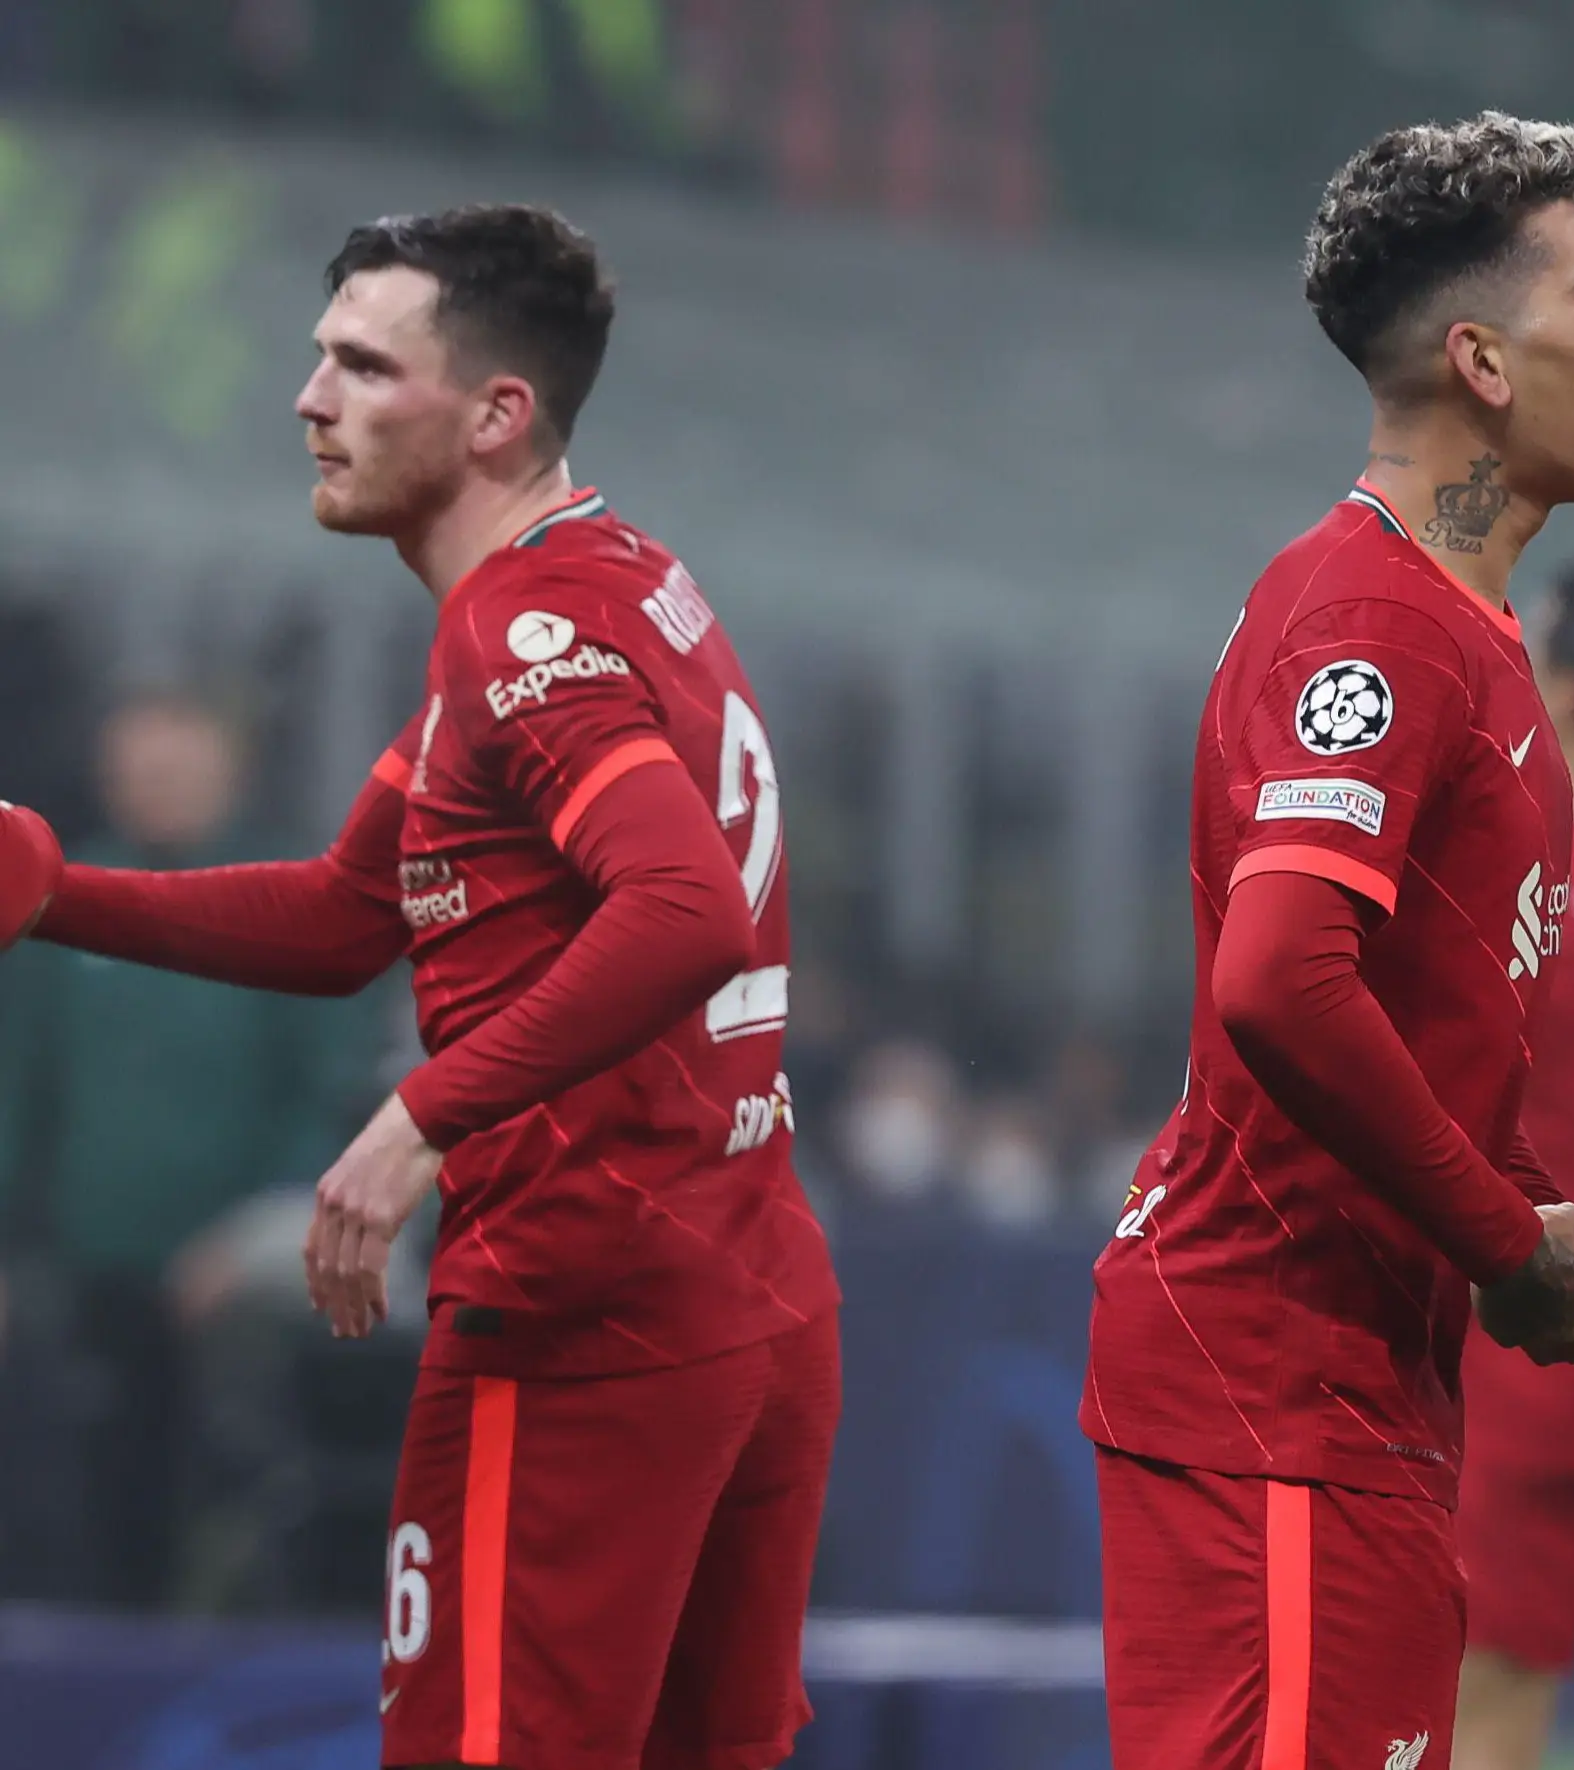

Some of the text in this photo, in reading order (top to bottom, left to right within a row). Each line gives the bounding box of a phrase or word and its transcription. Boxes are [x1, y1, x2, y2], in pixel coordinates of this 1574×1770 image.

[1418, 518, 1483, 555] Deus
[484, 644, 630, 720] Expedia
[1265, 783, 1293, 793] UEFA
[1262, 790, 1381, 820] FOUNDATION
